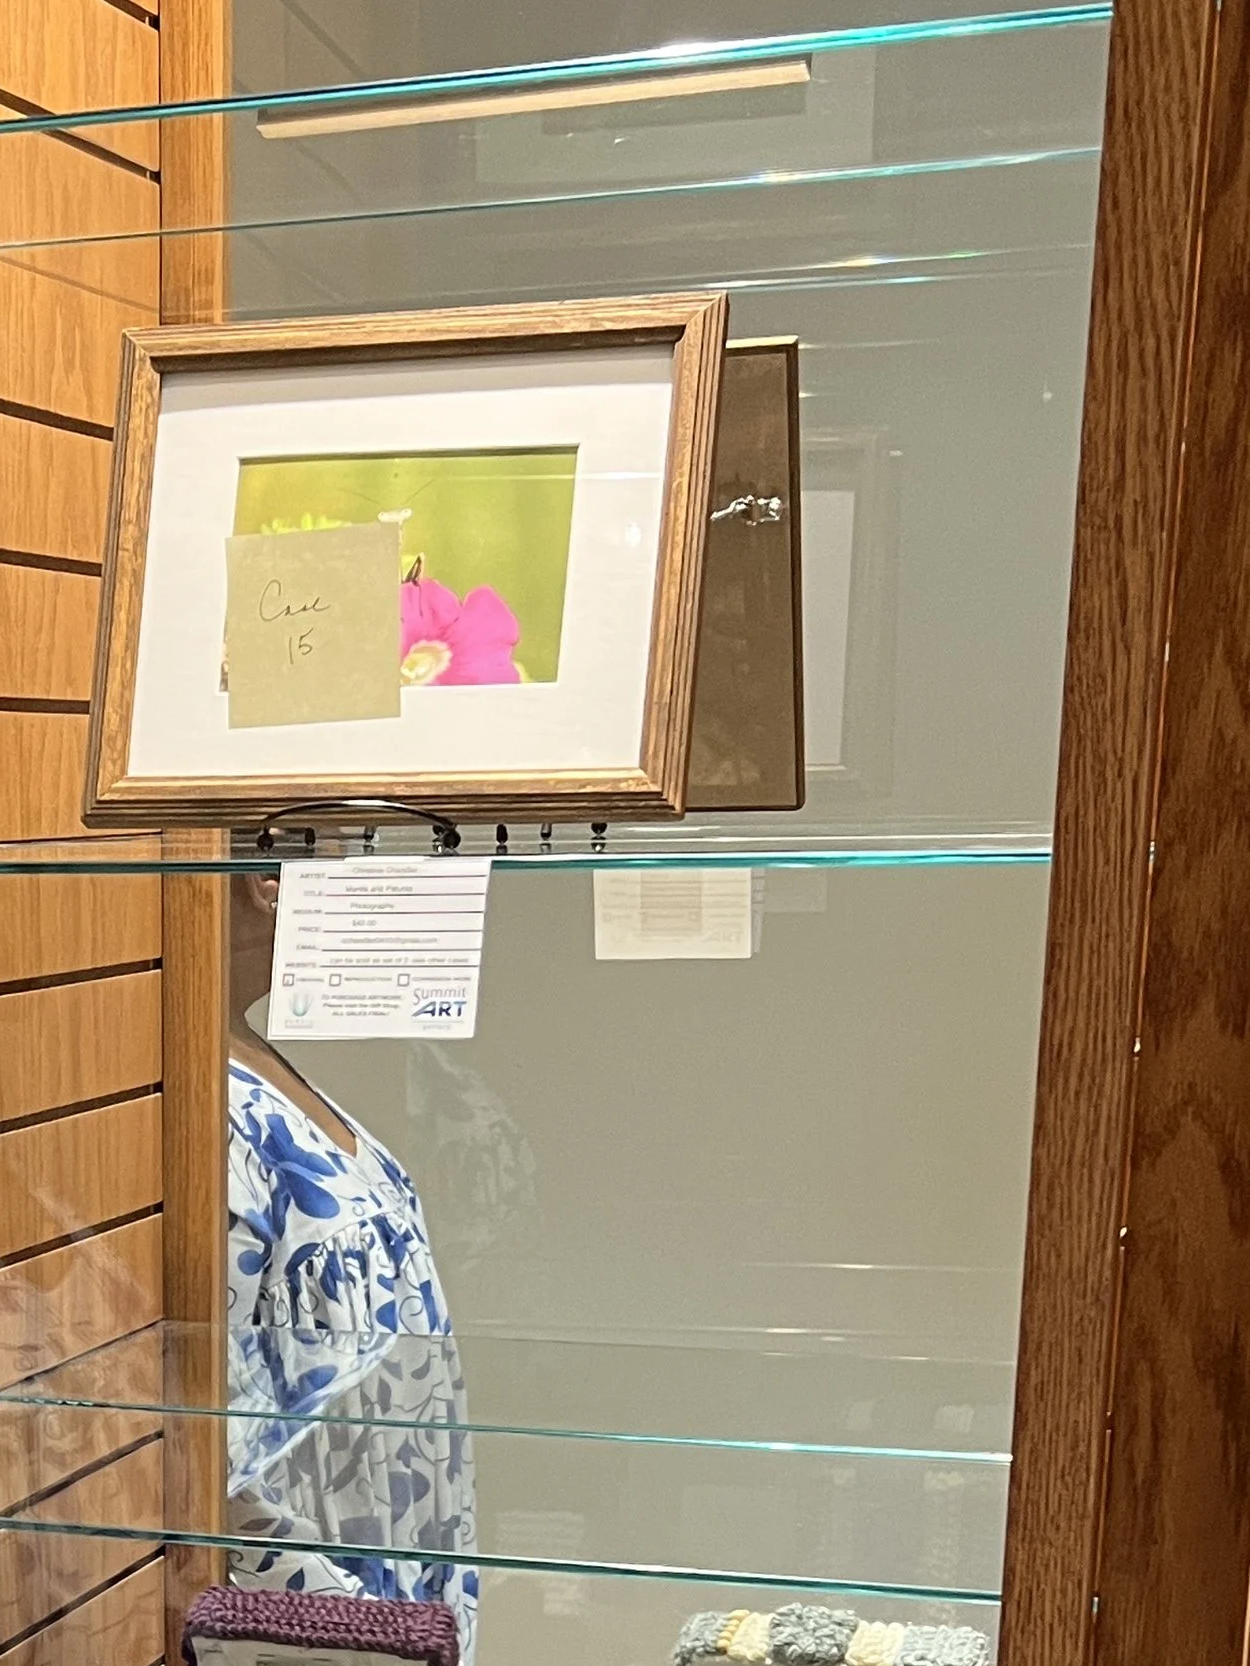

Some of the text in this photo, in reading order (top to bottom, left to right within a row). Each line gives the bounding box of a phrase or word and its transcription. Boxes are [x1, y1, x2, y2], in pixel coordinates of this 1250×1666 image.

[259, 579, 331, 621] Case
[289, 628, 314, 665] 15
[412, 1001, 467, 1017] ART
[413, 987, 467, 1006] Summit
